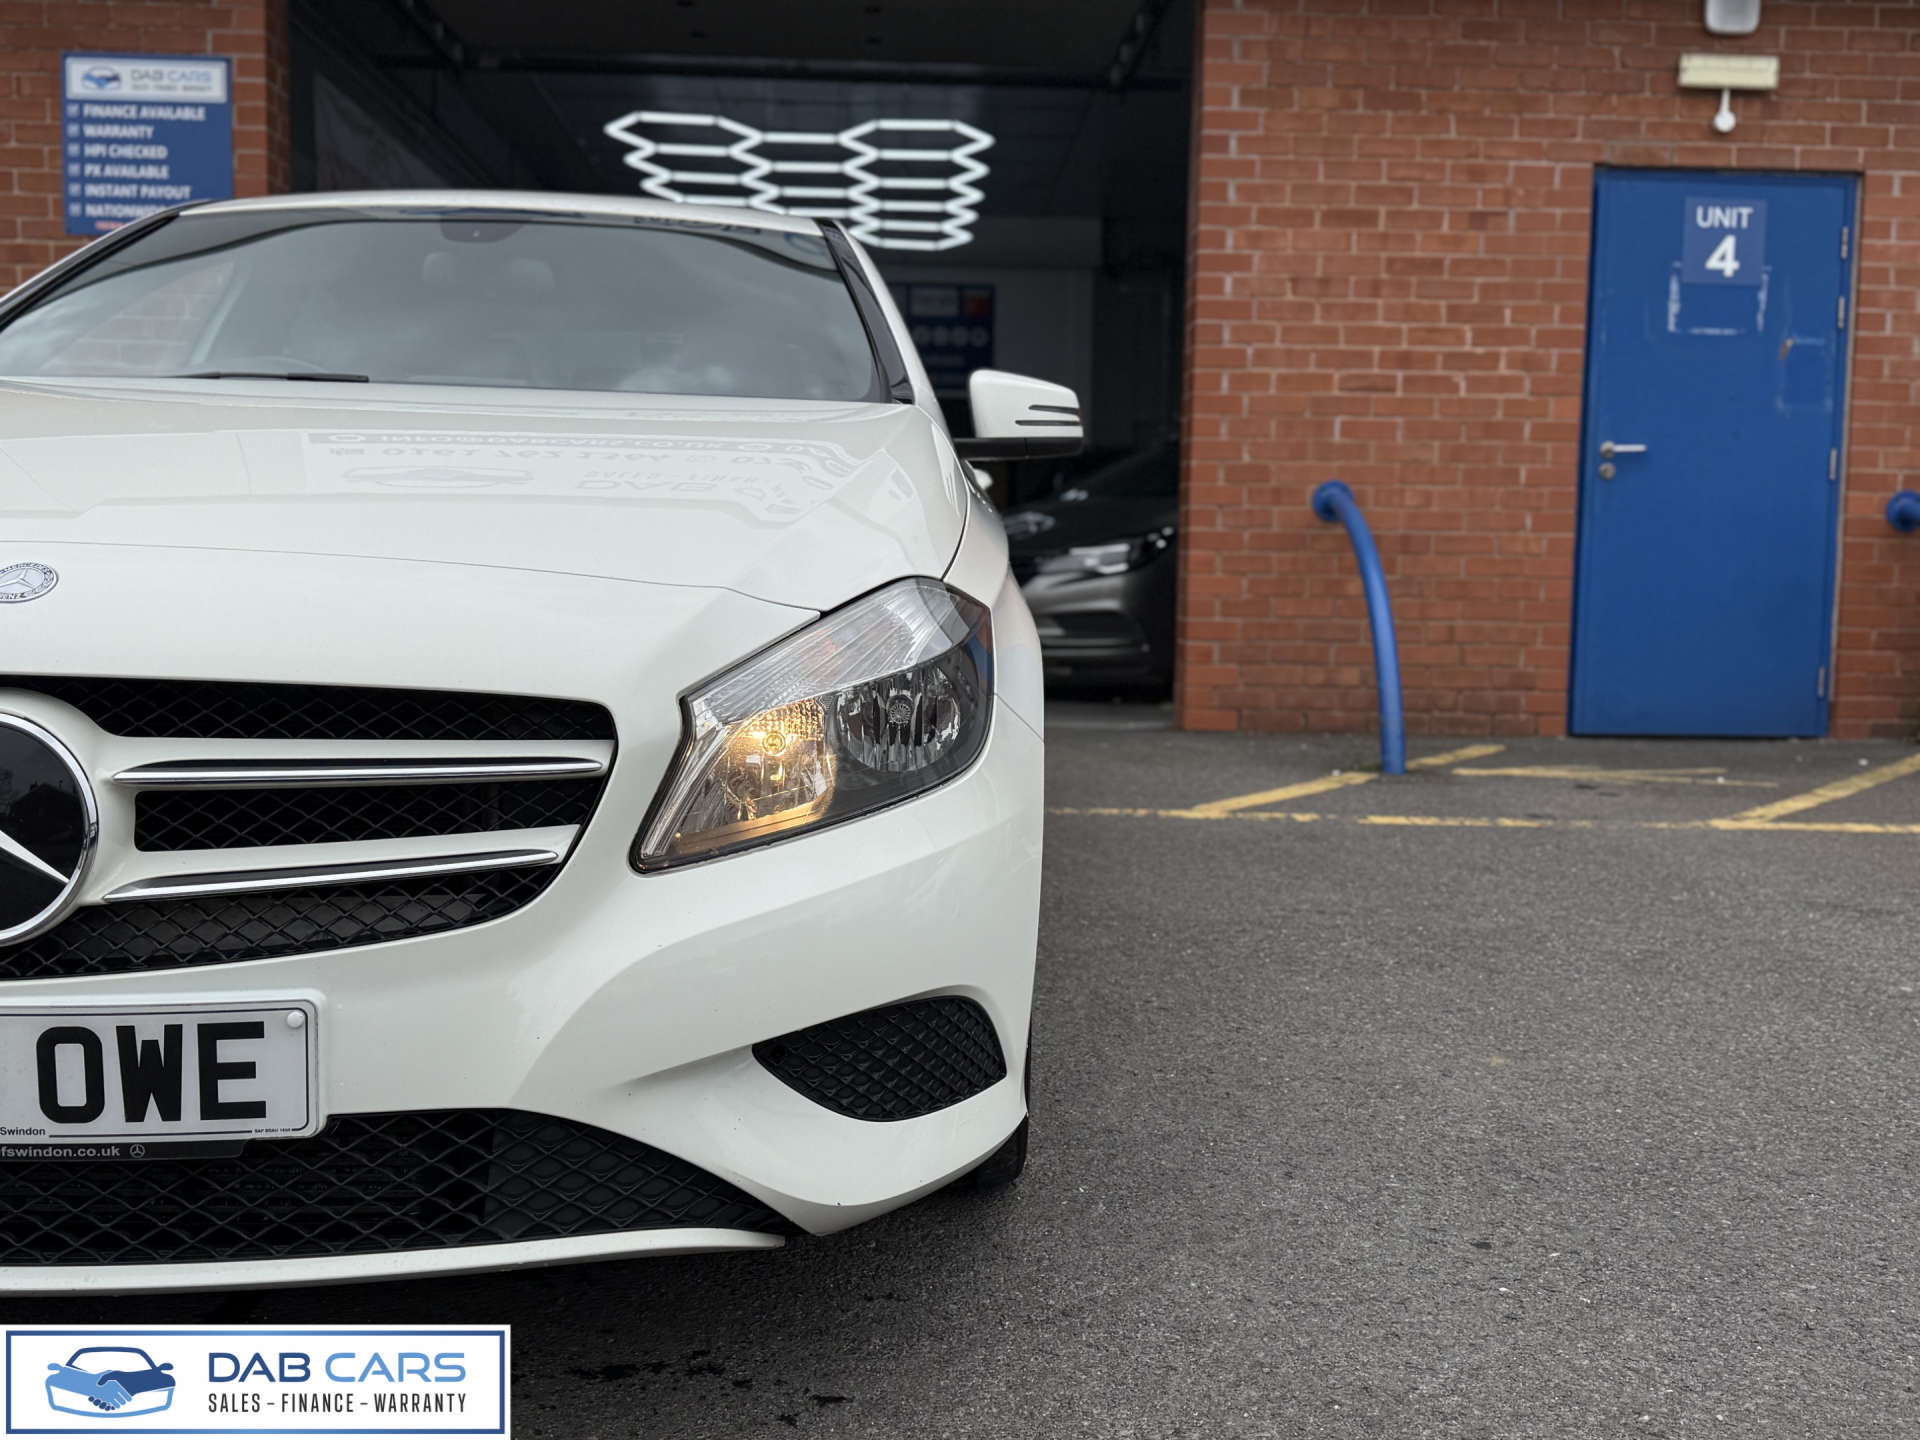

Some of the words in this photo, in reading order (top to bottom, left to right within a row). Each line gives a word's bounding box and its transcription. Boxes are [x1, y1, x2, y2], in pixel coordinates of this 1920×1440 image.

[83, 104, 138, 119] FINANCE
[139, 106, 206, 121] AVAILABLE
[83, 124, 154, 139] WARRANTY
[84, 145, 107, 158] HPI
[108, 145, 168, 159] CHECKED
[84, 164, 103, 178] PX
[104, 165, 169, 180] AVAILABLE
[84, 184, 138, 198] INSTANT
[140, 185, 191, 199] PAYOUT
[1696, 205, 1754, 229] UNIT
[1705, 234, 1740, 278] 4
[36, 1021, 267, 1124] OWE
[0, 1126, 46, 1137] Swindon
